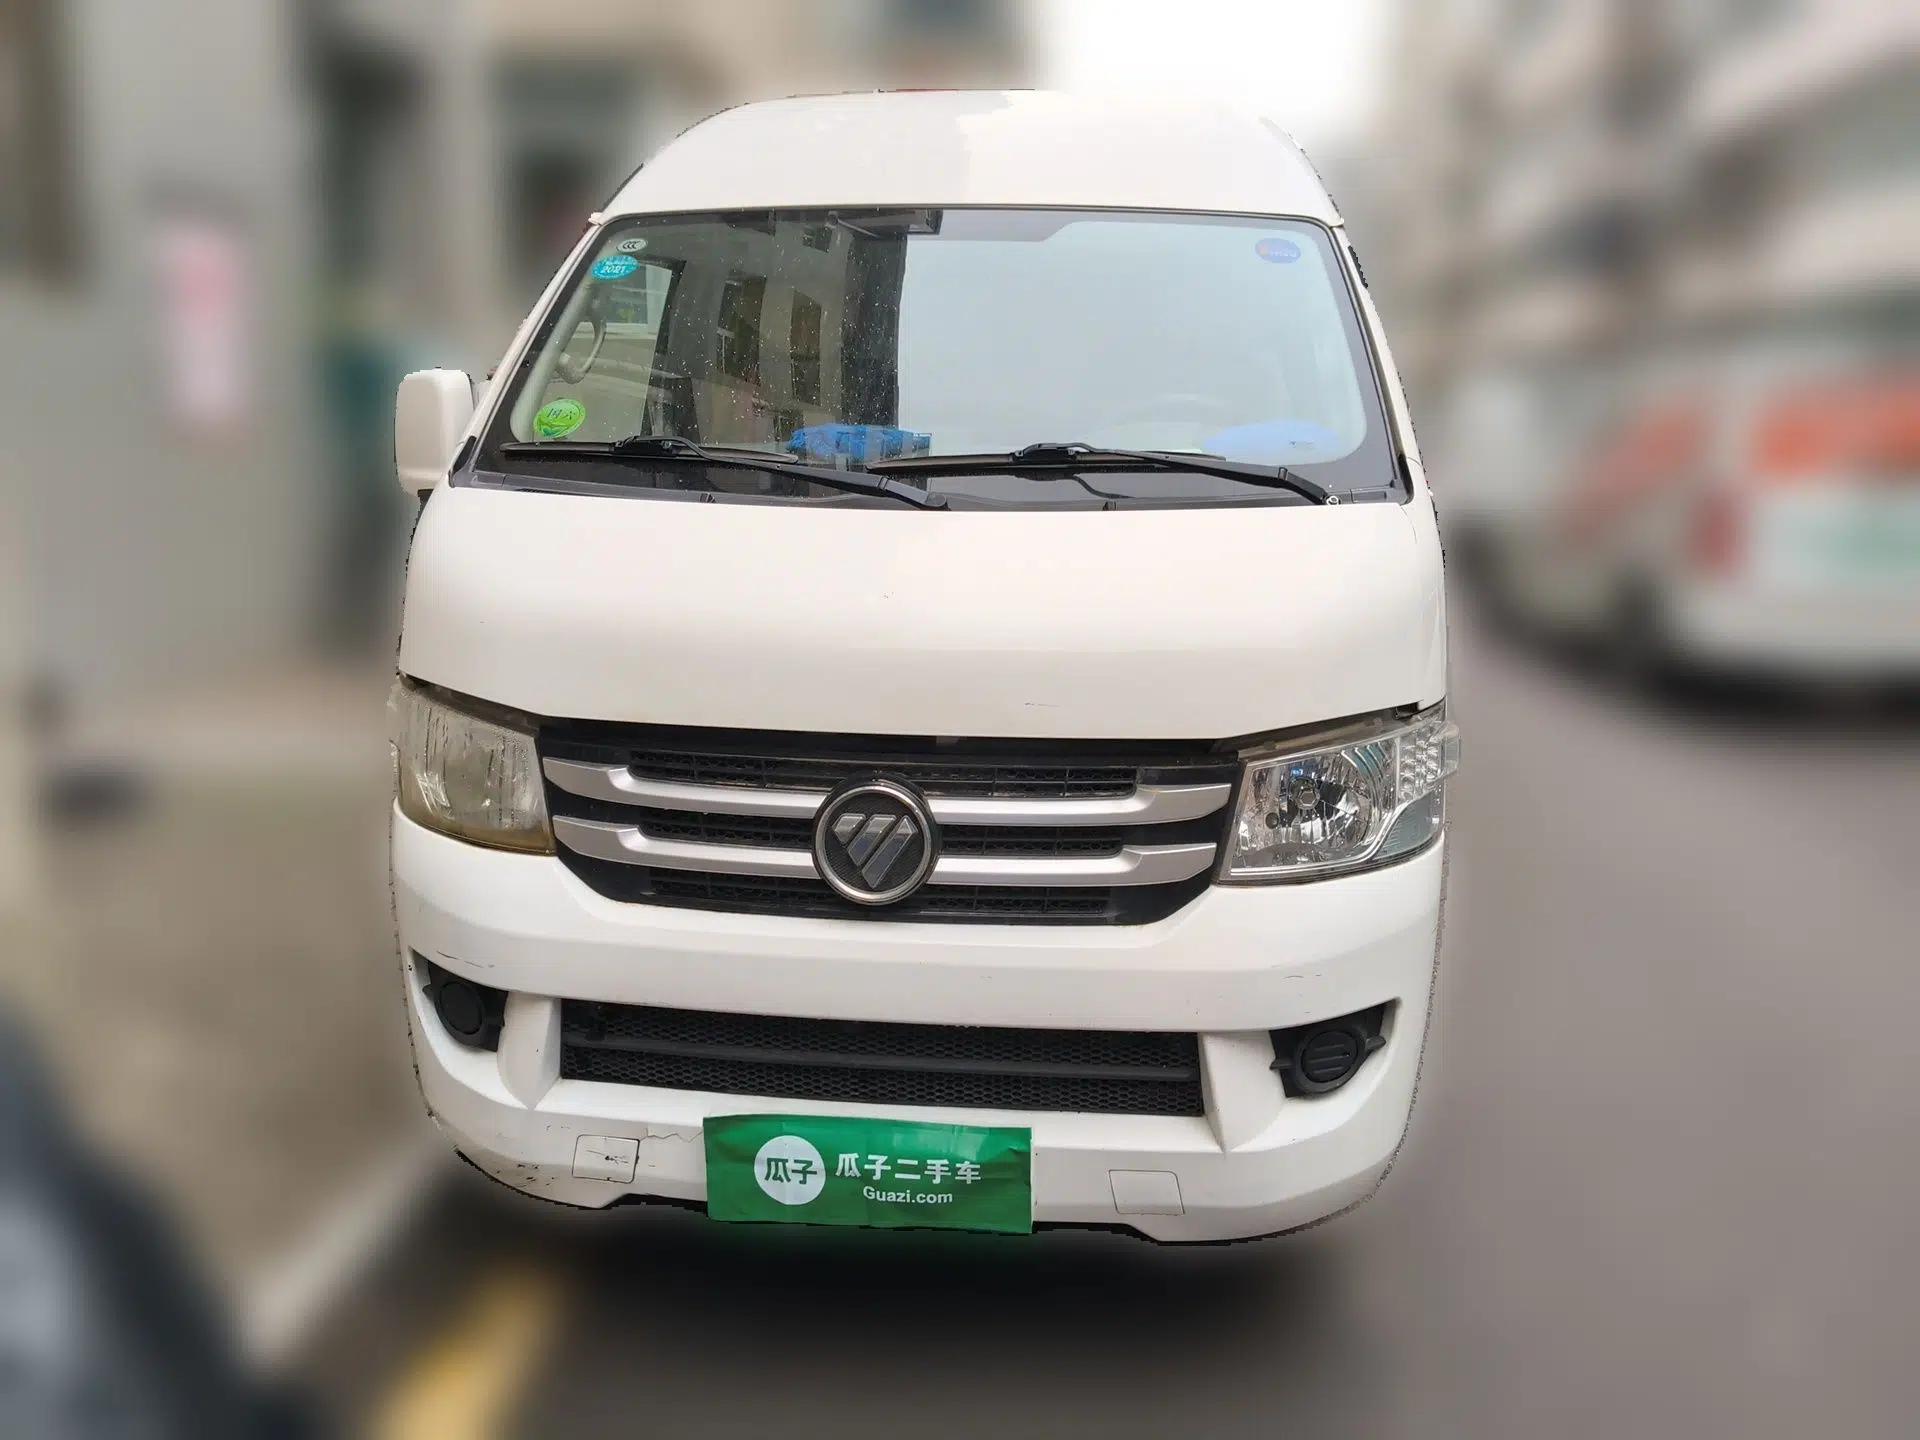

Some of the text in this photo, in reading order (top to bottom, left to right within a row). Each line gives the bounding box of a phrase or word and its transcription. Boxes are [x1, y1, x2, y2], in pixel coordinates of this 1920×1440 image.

[600, 264, 626, 274] 2021
[765, 1157, 818, 1185] 瓜子
[835, 1152, 982, 1185] 瓜子二手车
[863, 1185, 953, 1204] Guazi.com
